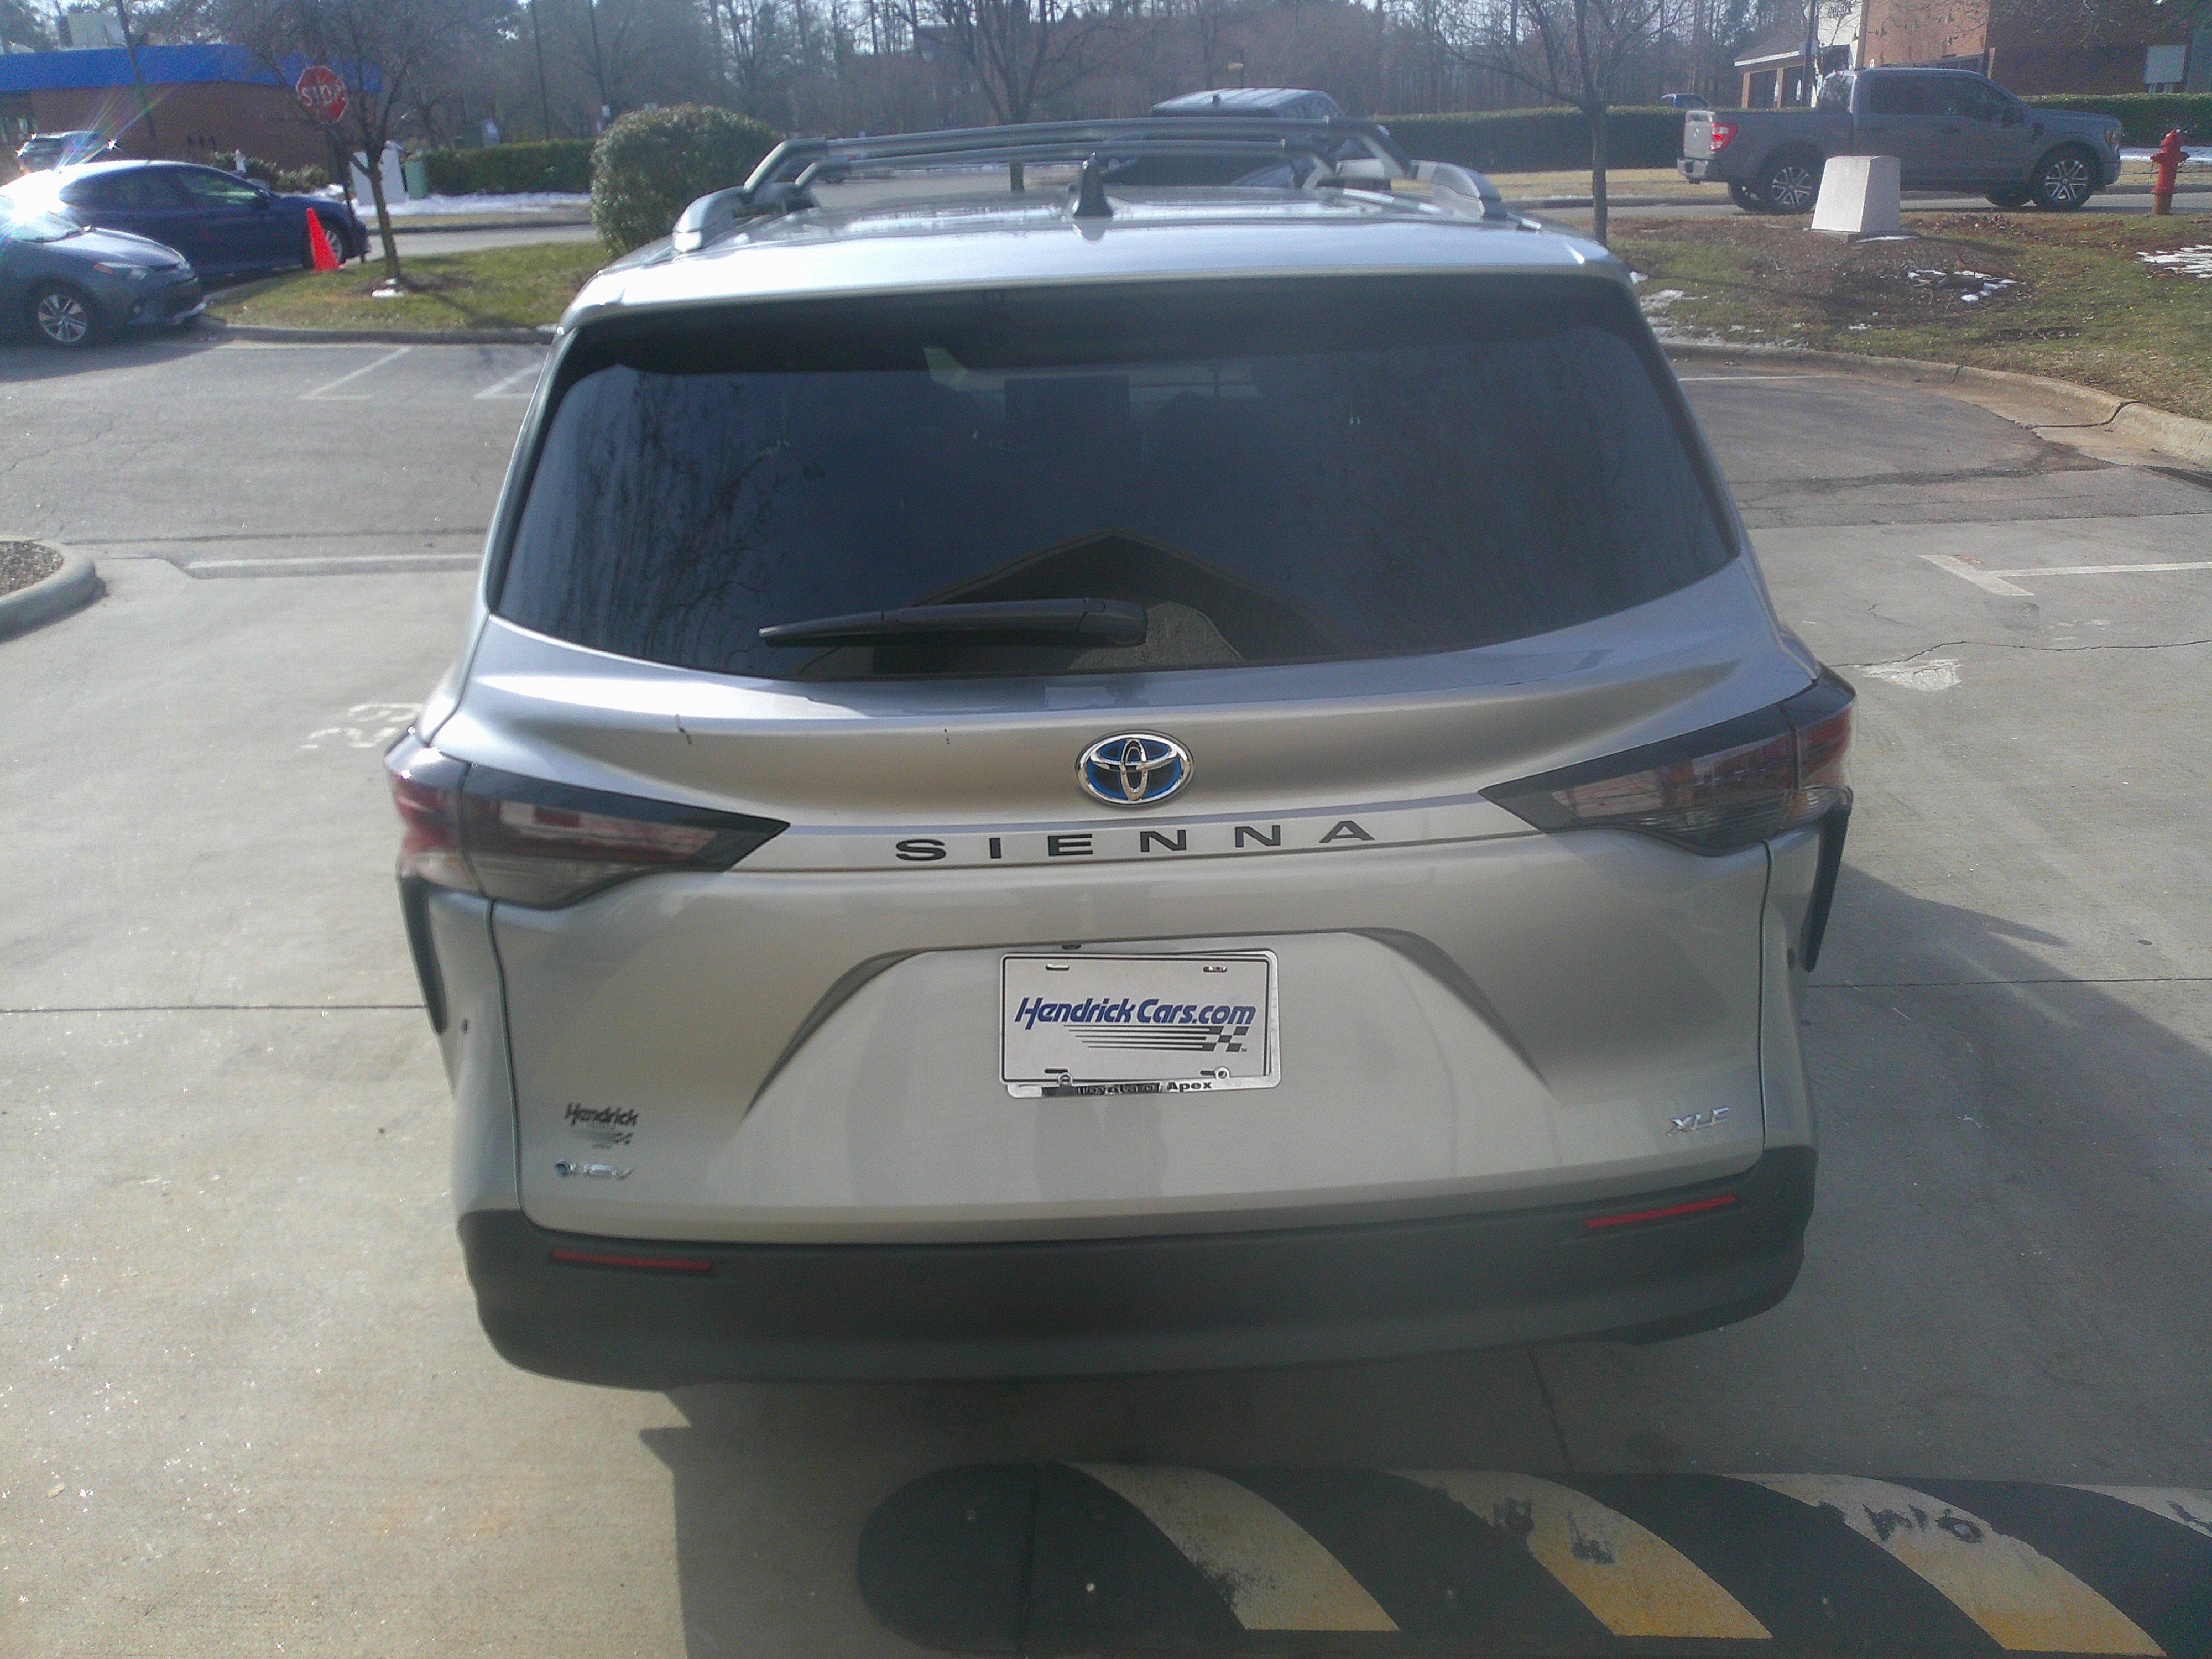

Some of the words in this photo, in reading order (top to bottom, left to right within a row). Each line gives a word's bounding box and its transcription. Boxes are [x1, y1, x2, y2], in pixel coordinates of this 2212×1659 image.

[301, 84, 343, 107] STOP
[895, 820, 1375, 862] SIENNA
[1014, 997, 1256, 1030] HendrickCars.com
[1166, 1081, 1212, 1093] Apex
[565, 1102, 639, 1126] Hendrick
